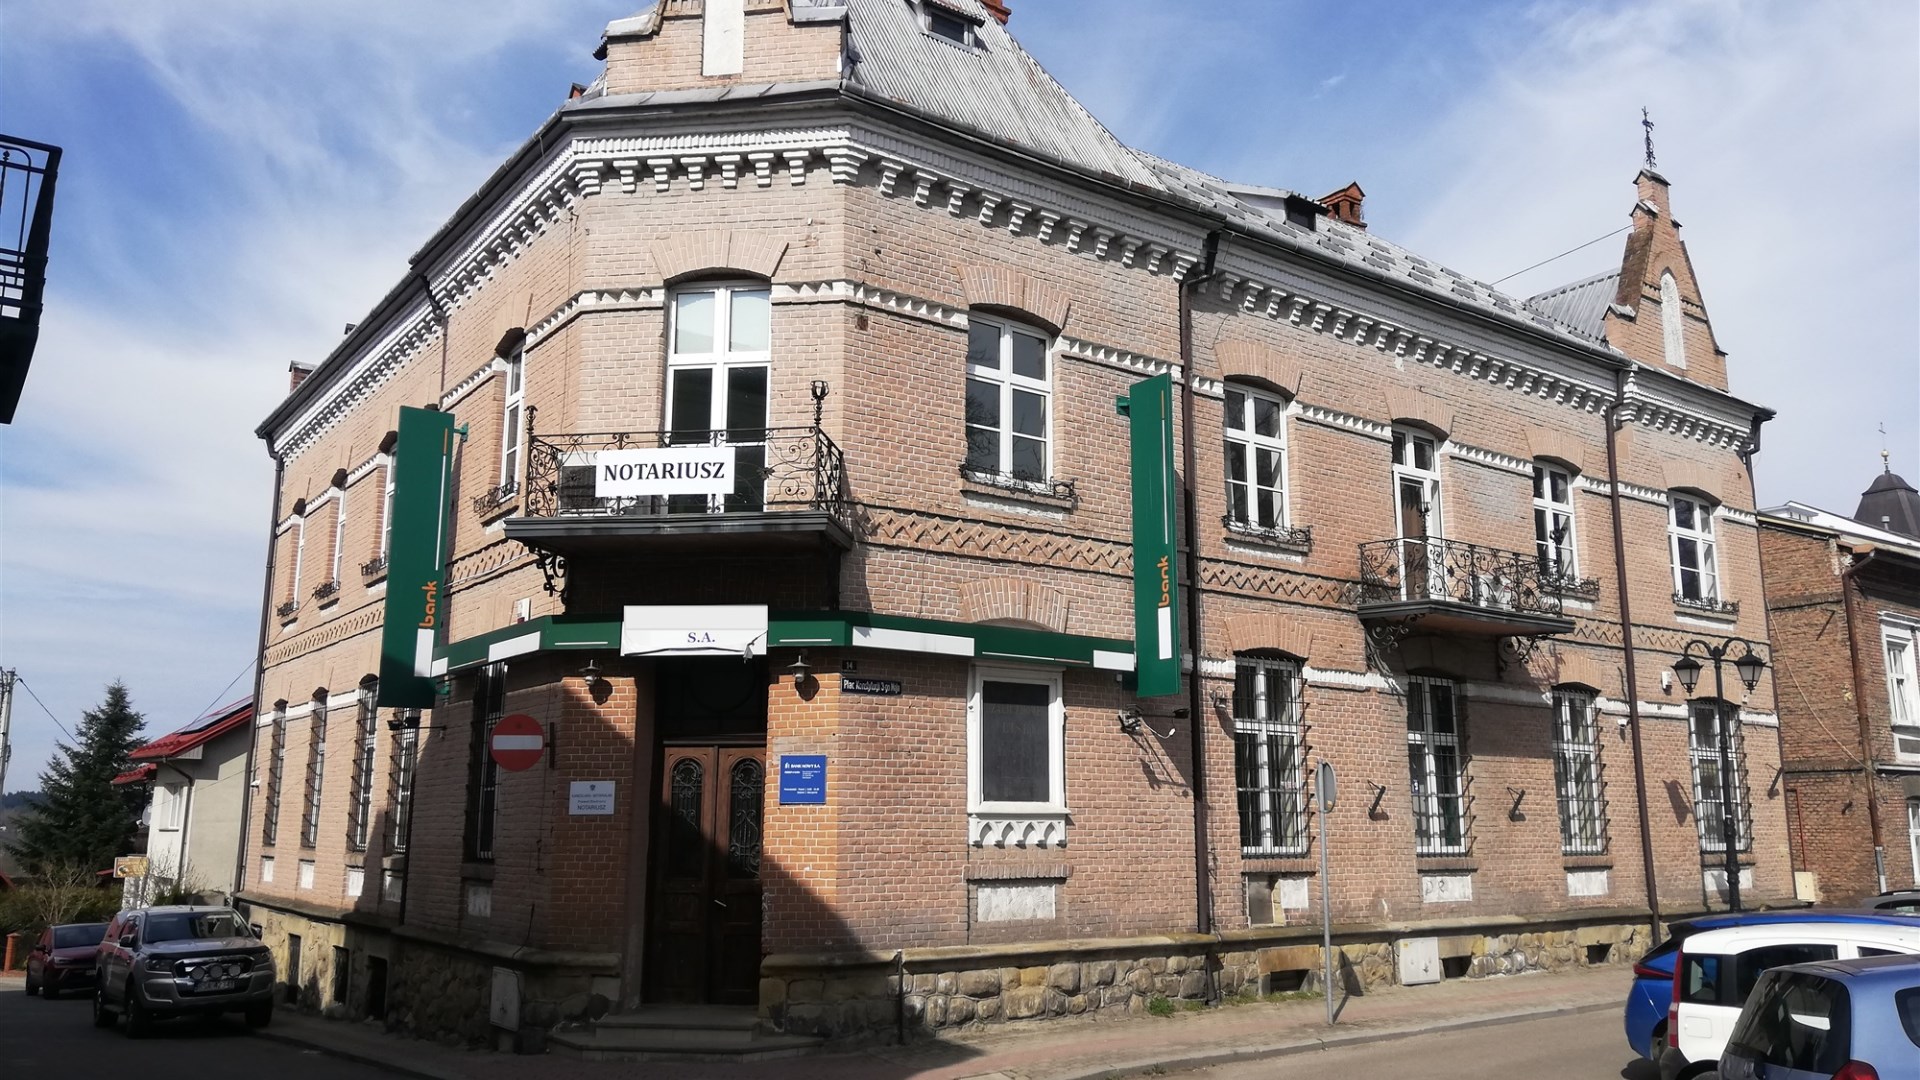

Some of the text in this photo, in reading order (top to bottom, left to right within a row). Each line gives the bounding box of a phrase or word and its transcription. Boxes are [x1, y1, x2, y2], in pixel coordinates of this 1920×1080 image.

[603, 461, 726, 482] NOTARIUSZ
[1157, 555, 1170, 607] bank
[418, 581, 438, 629] bank
[686, 631, 716, 643] S.A.
[843, 679, 855, 690] Plac
